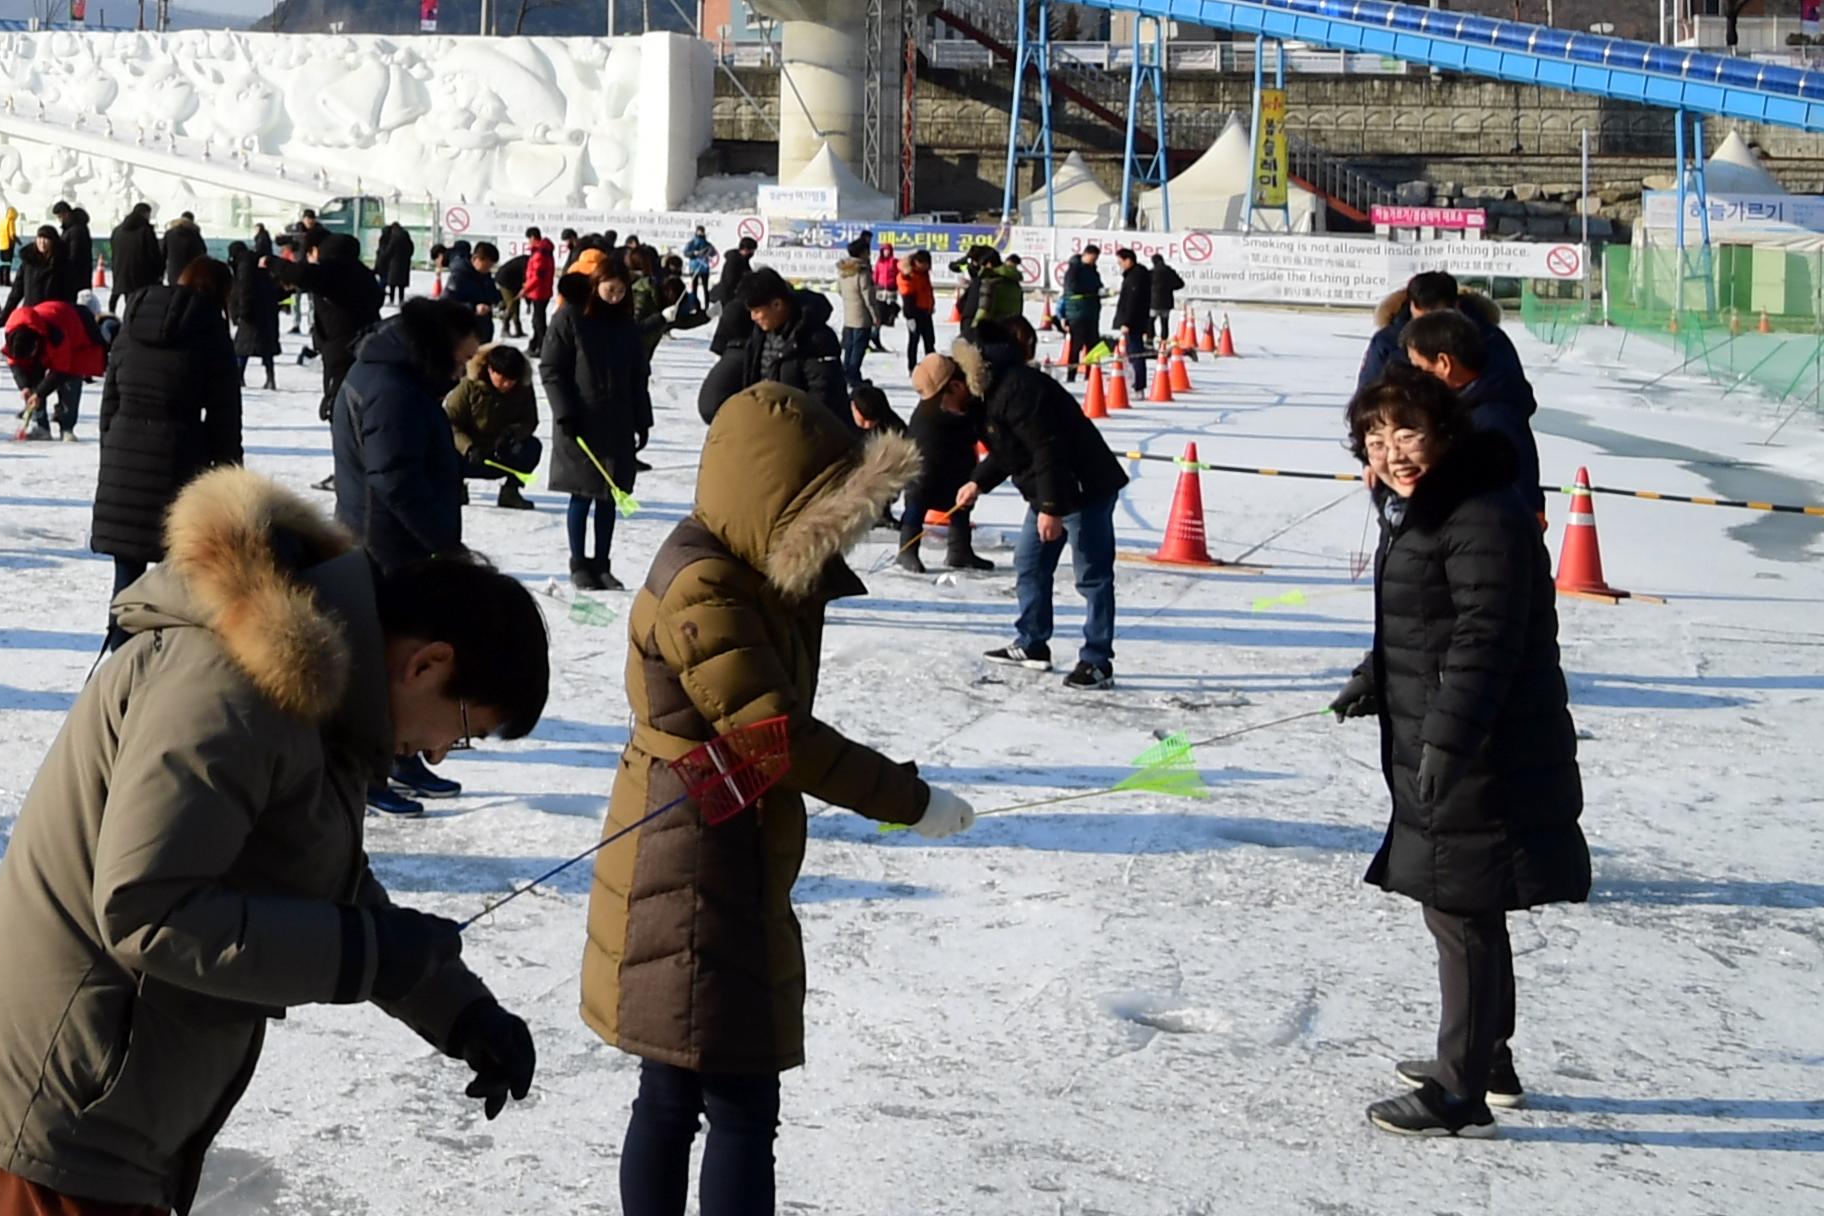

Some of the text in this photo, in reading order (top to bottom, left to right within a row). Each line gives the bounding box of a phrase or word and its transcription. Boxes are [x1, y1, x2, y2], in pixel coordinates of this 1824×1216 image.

[548, 213, 564, 221] not
[567, 213, 605, 222] allowed
[639, 215, 656, 224] the
[1071, 237, 1082, 254] 3
[1131, 241, 1164, 257] Per
[1242, 237, 1294, 252] Smoking
[1298, 243, 1307, 251] is
[1311, 242, 1330, 252] not
[1333, 243, 1381, 255] allowed
[1384, 245, 1421, 256] inside
[1424, 245, 1444, 256] the
[1447, 244, 1489, 257] fishing
[1199, 270, 1245, 281] allowed
[1248, 270, 1284, 281] inside
[1287, 270, 1307, 282] the
[1310, 271, 1350, 286] fishing
